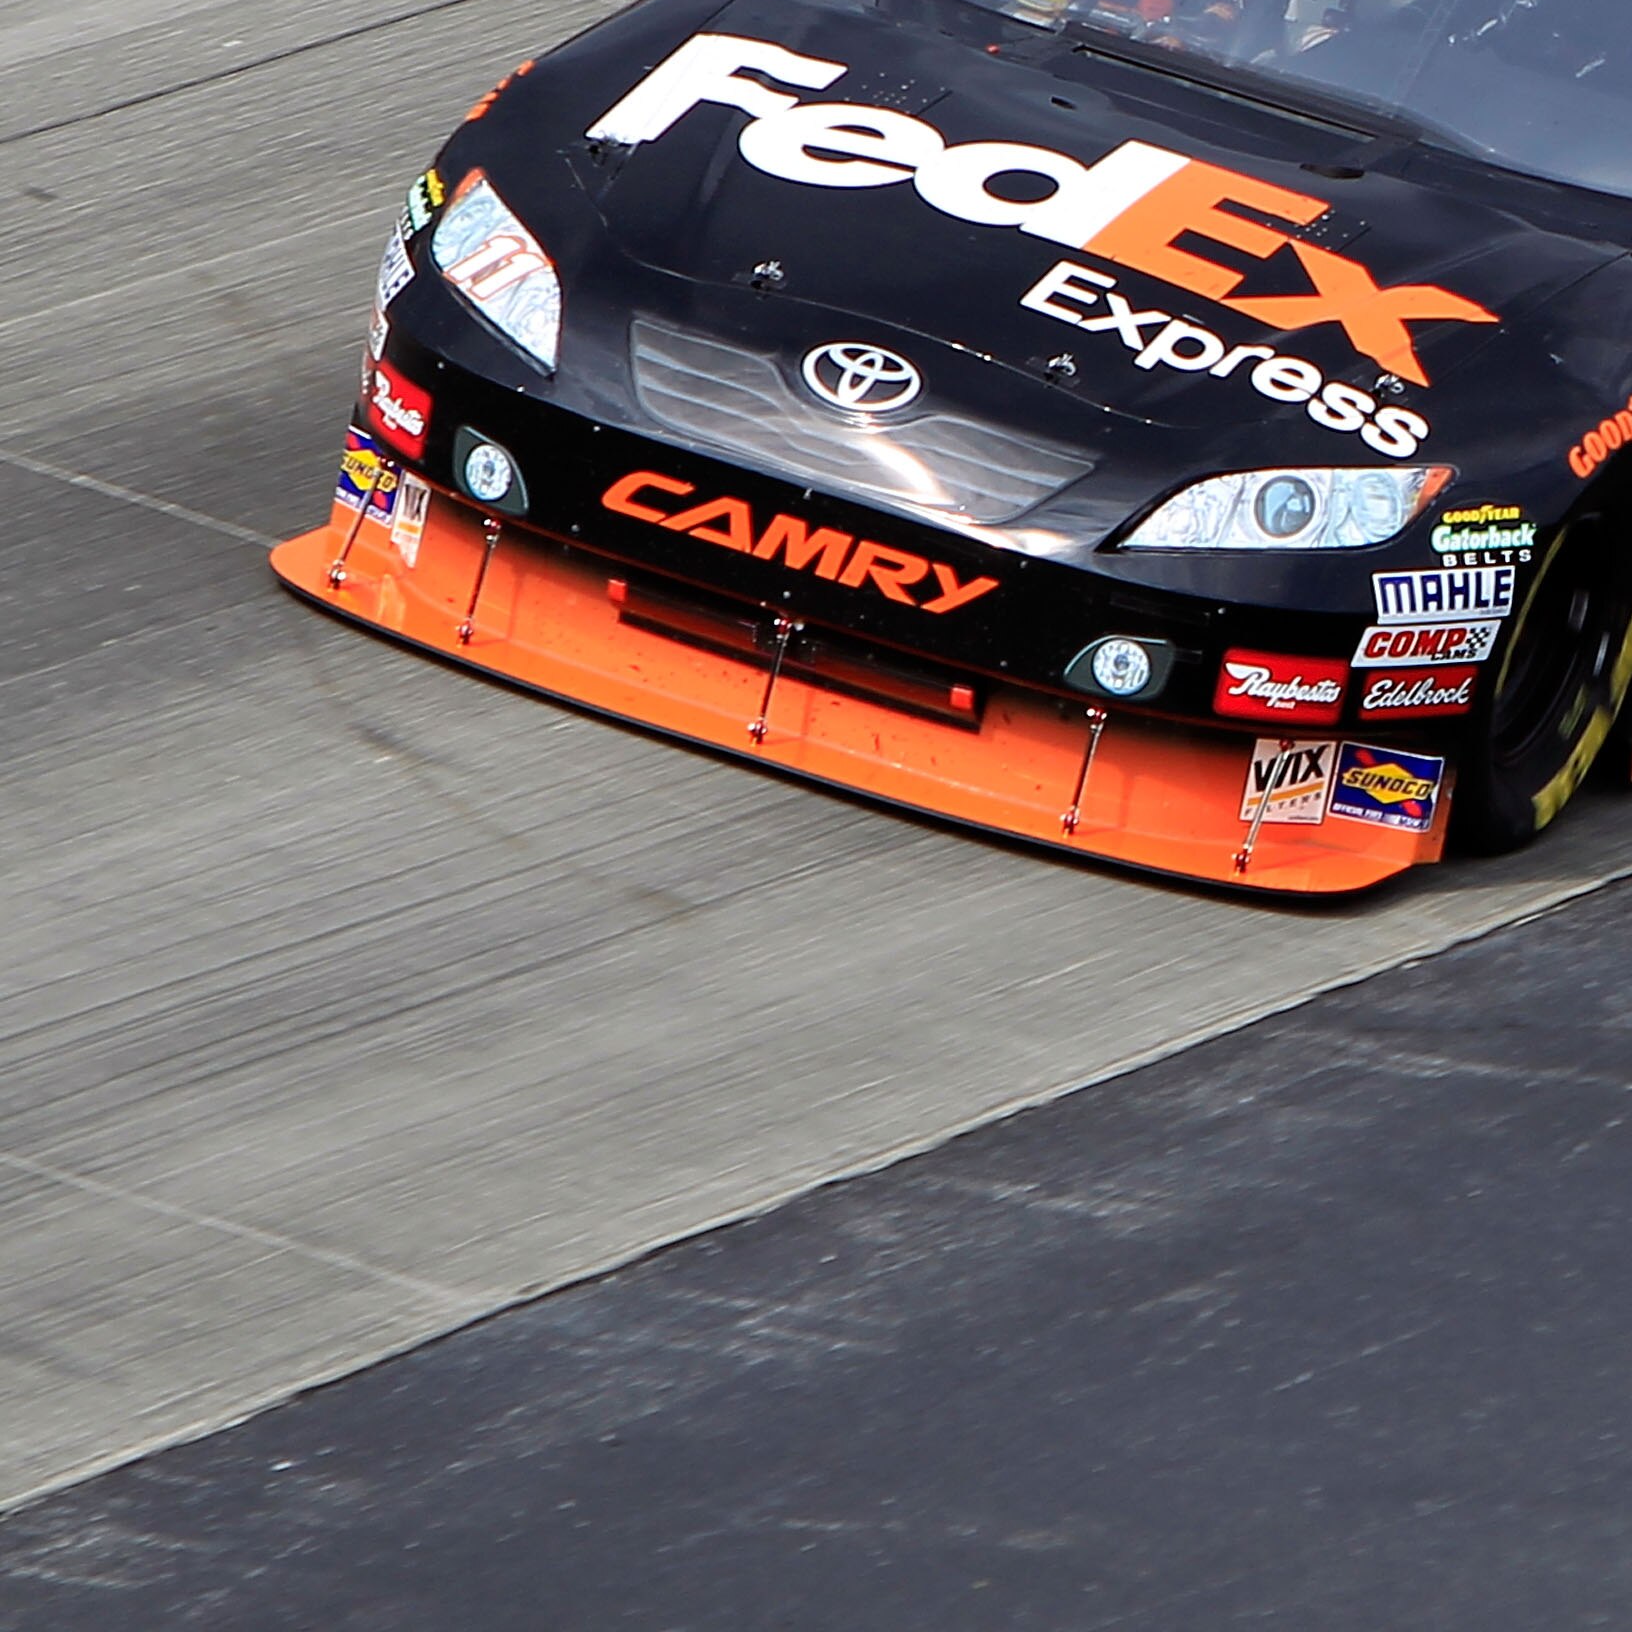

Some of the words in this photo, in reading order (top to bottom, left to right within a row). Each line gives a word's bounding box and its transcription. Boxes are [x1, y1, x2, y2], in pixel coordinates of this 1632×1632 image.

[584, 32, 1500, 388] FedEx
[442, 234, 555, 303] 11
[1018, 259, 1430, 459] Express
[341, 450, 398, 490] SUNOO
[1441, 504, 1521, 525] GOODYEAR
[600, 469, 999, 614] CAMRY
[1430, 522, 1538, 554] Gatorback
[1441, 548, 1533, 568] BELTS
[1378, 568, 1512, 615] MAHLE
[1362, 627, 1468, 660] COMP
[1430, 648, 1478, 662] CAMS
[1224, 661, 1342, 707] Raybestos
[1362, 676, 1471, 710] Edelbrock
[1253, 744, 1329, 793] WIX
[1343, 768, 1434, 801] SUNOCO
[1244, 790, 1323, 819] FLTERS
